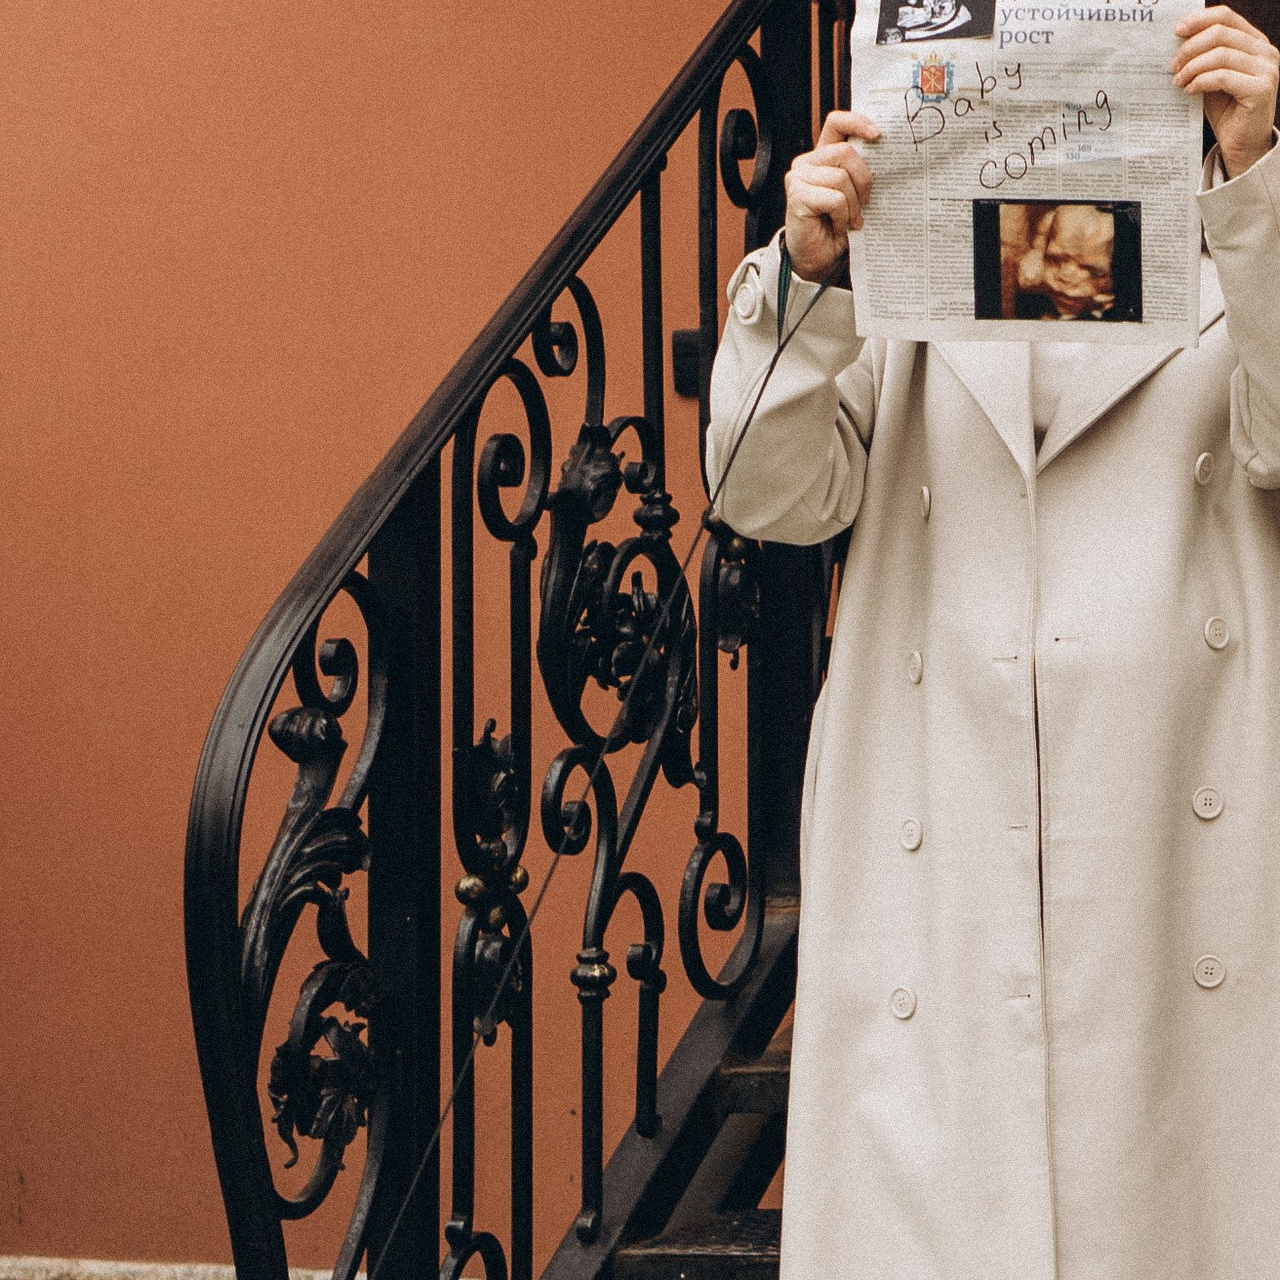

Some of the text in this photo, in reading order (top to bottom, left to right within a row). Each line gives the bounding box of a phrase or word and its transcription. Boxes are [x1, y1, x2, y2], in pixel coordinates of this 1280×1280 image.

[1000, 4, 1154, 27] устойчивый
[999, 28, 1054, 50] рост
[905, 61, 1022, 151] Baby
[980, 89, 1112, 189] coming
[983, 121, 1003, 143] is
